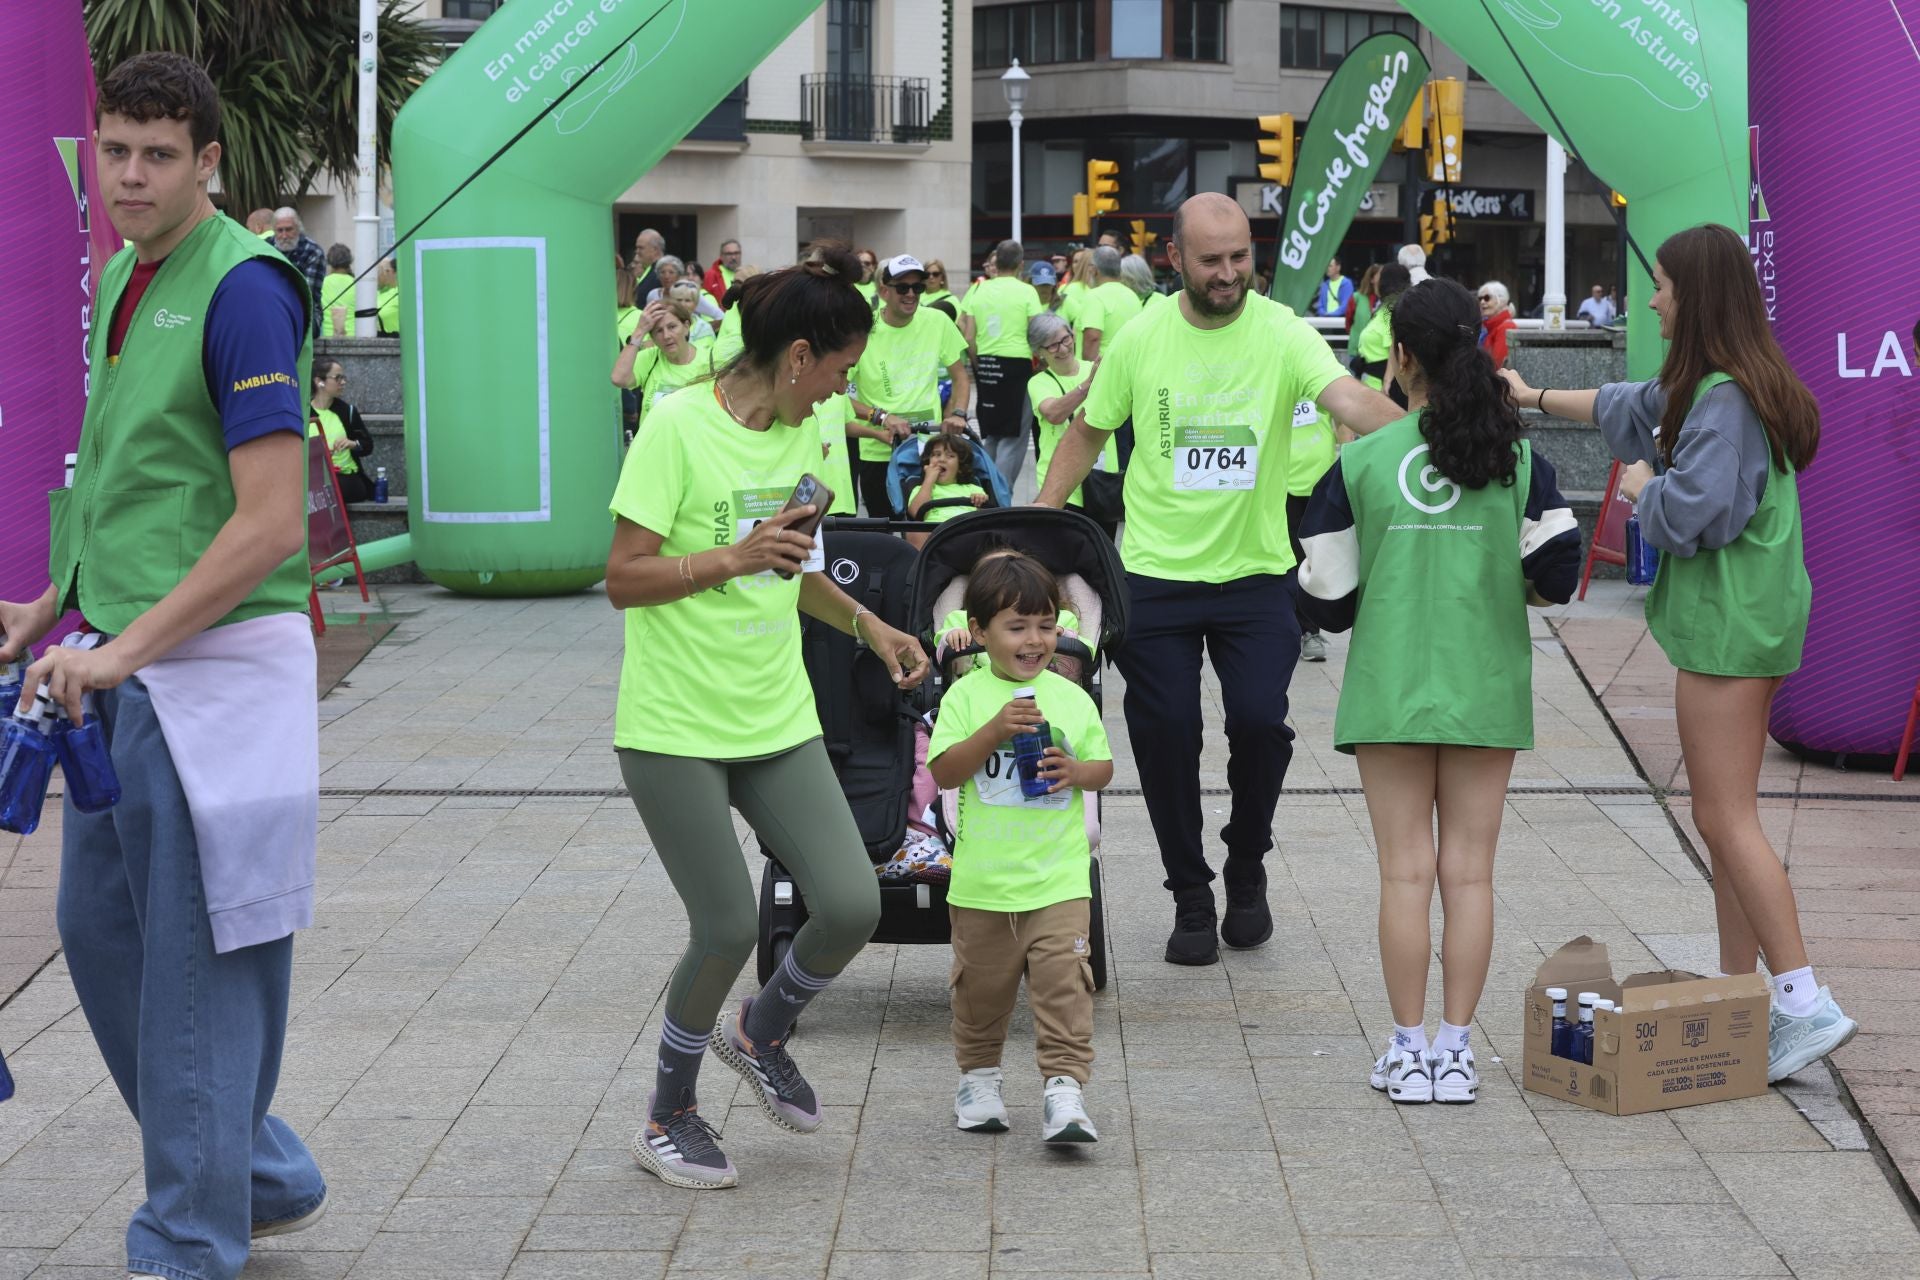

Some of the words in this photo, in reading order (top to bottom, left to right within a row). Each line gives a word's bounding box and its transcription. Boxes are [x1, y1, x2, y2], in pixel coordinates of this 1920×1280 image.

[483, 52, 515, 82] En
[514, 0, 574, 54] marc
[505, 76, 531, 103] el
[528, 10, 599, 81] cáncer
[1619, 15, 1713, 100] Asturias
[1280, 230, 1311, 270] El
[1298, 157, 1352, 235] Corte
[234, 372, 290, 392] AMBILIGHT
[1294, 402, 1310, 416] 56
[1158, 387, 1171, 460] ASTURIAS
[1187, 447, 1246, 470] 0764
[712, 500, 730, 596] ARIAS
[986, 751, 1016, 780] 07
[1636, 1020, 1658, 1039] 50cl
[1638, 1040, 1654, 1052] x20
[1656, 1058, 1688, 1068] CREEMOS
[1700, 1052, 1731, 1061] ENVASES
[1696, 1058, 1741, 1070] SOSTENIBLES
[1662, 1083, 1693, 1094] RECICLADO
[1676, 1076, 1693, 1085] 100%
[1696, 1078, 1726, 1089] RECICLADO
